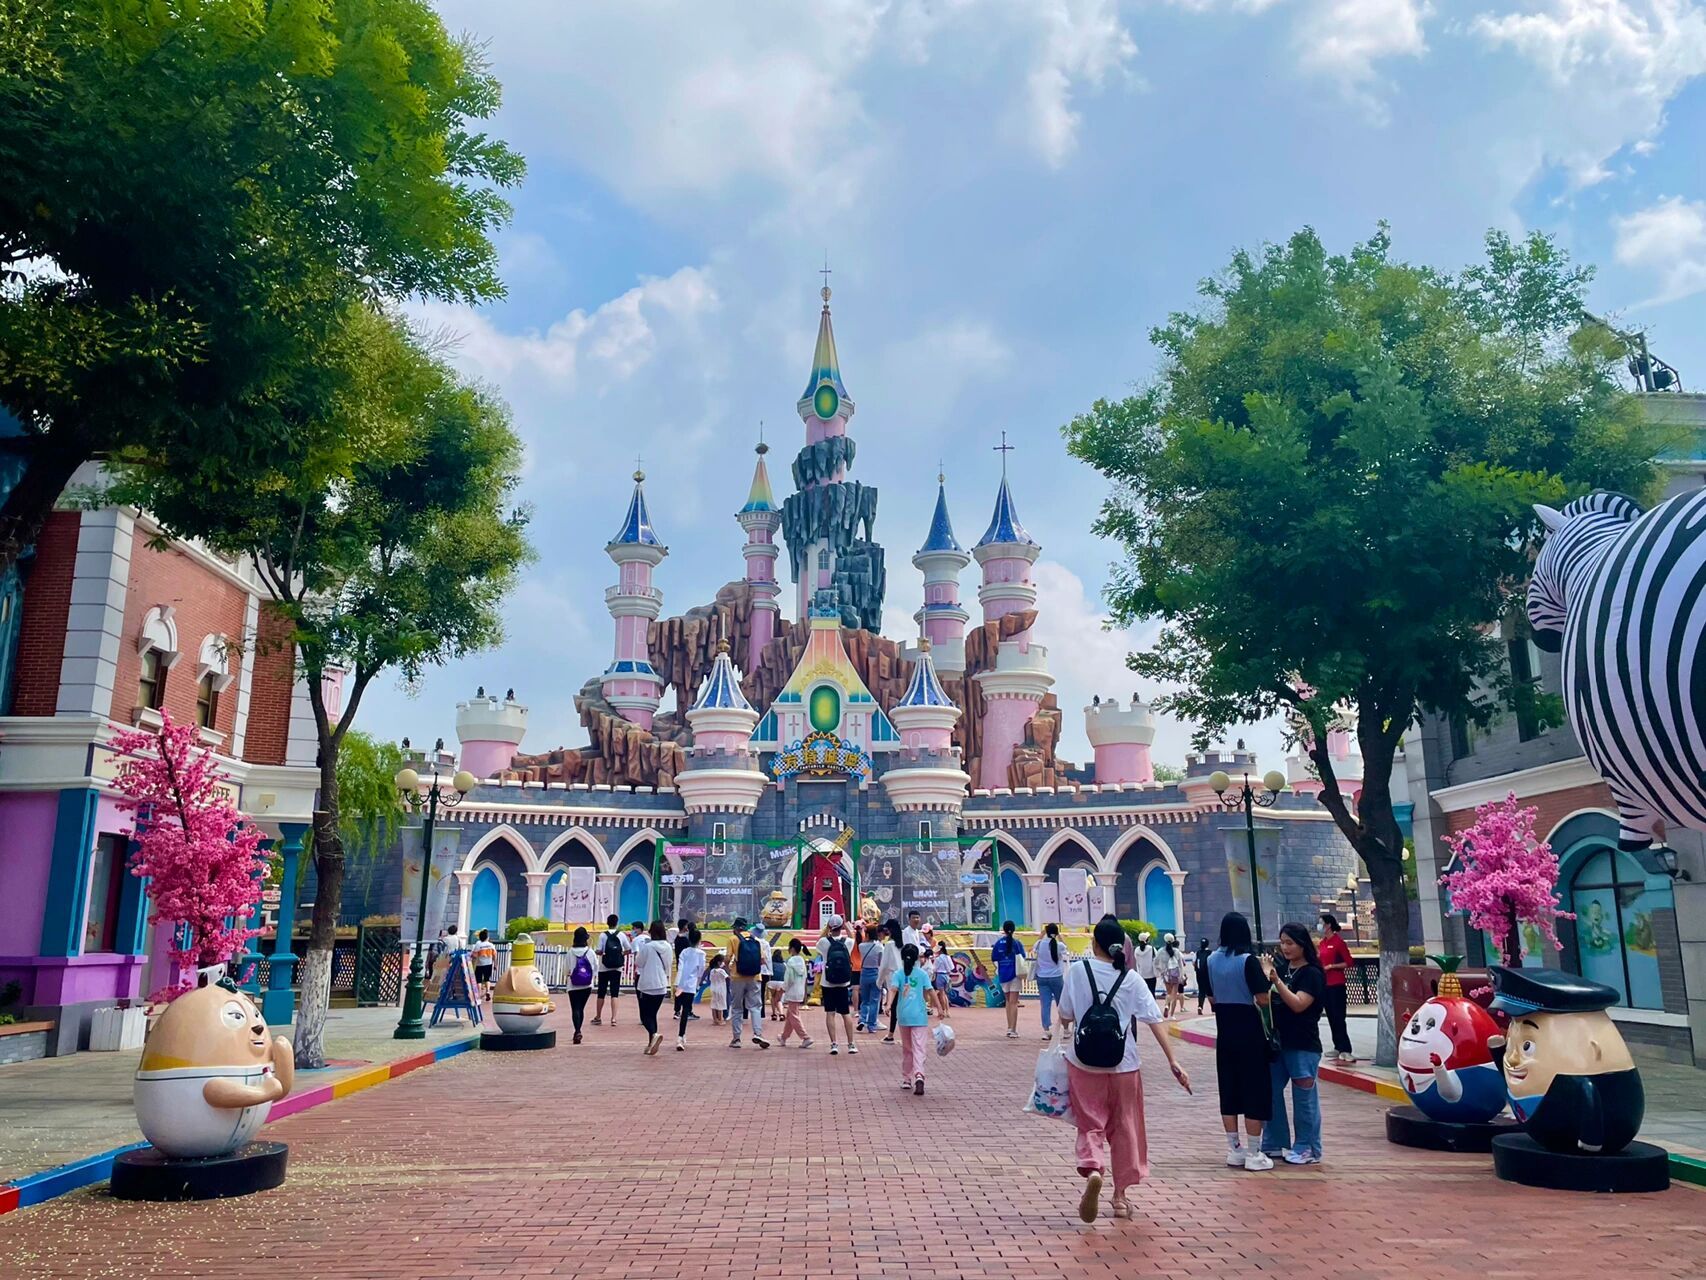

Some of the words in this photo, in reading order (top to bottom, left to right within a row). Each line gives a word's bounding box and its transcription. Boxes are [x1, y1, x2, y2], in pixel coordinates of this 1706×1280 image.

[783, 749, 858, 769] 方特城堡
[770, 846, 797, 859] Music
[913, 890, 937, 898] ENJOY
